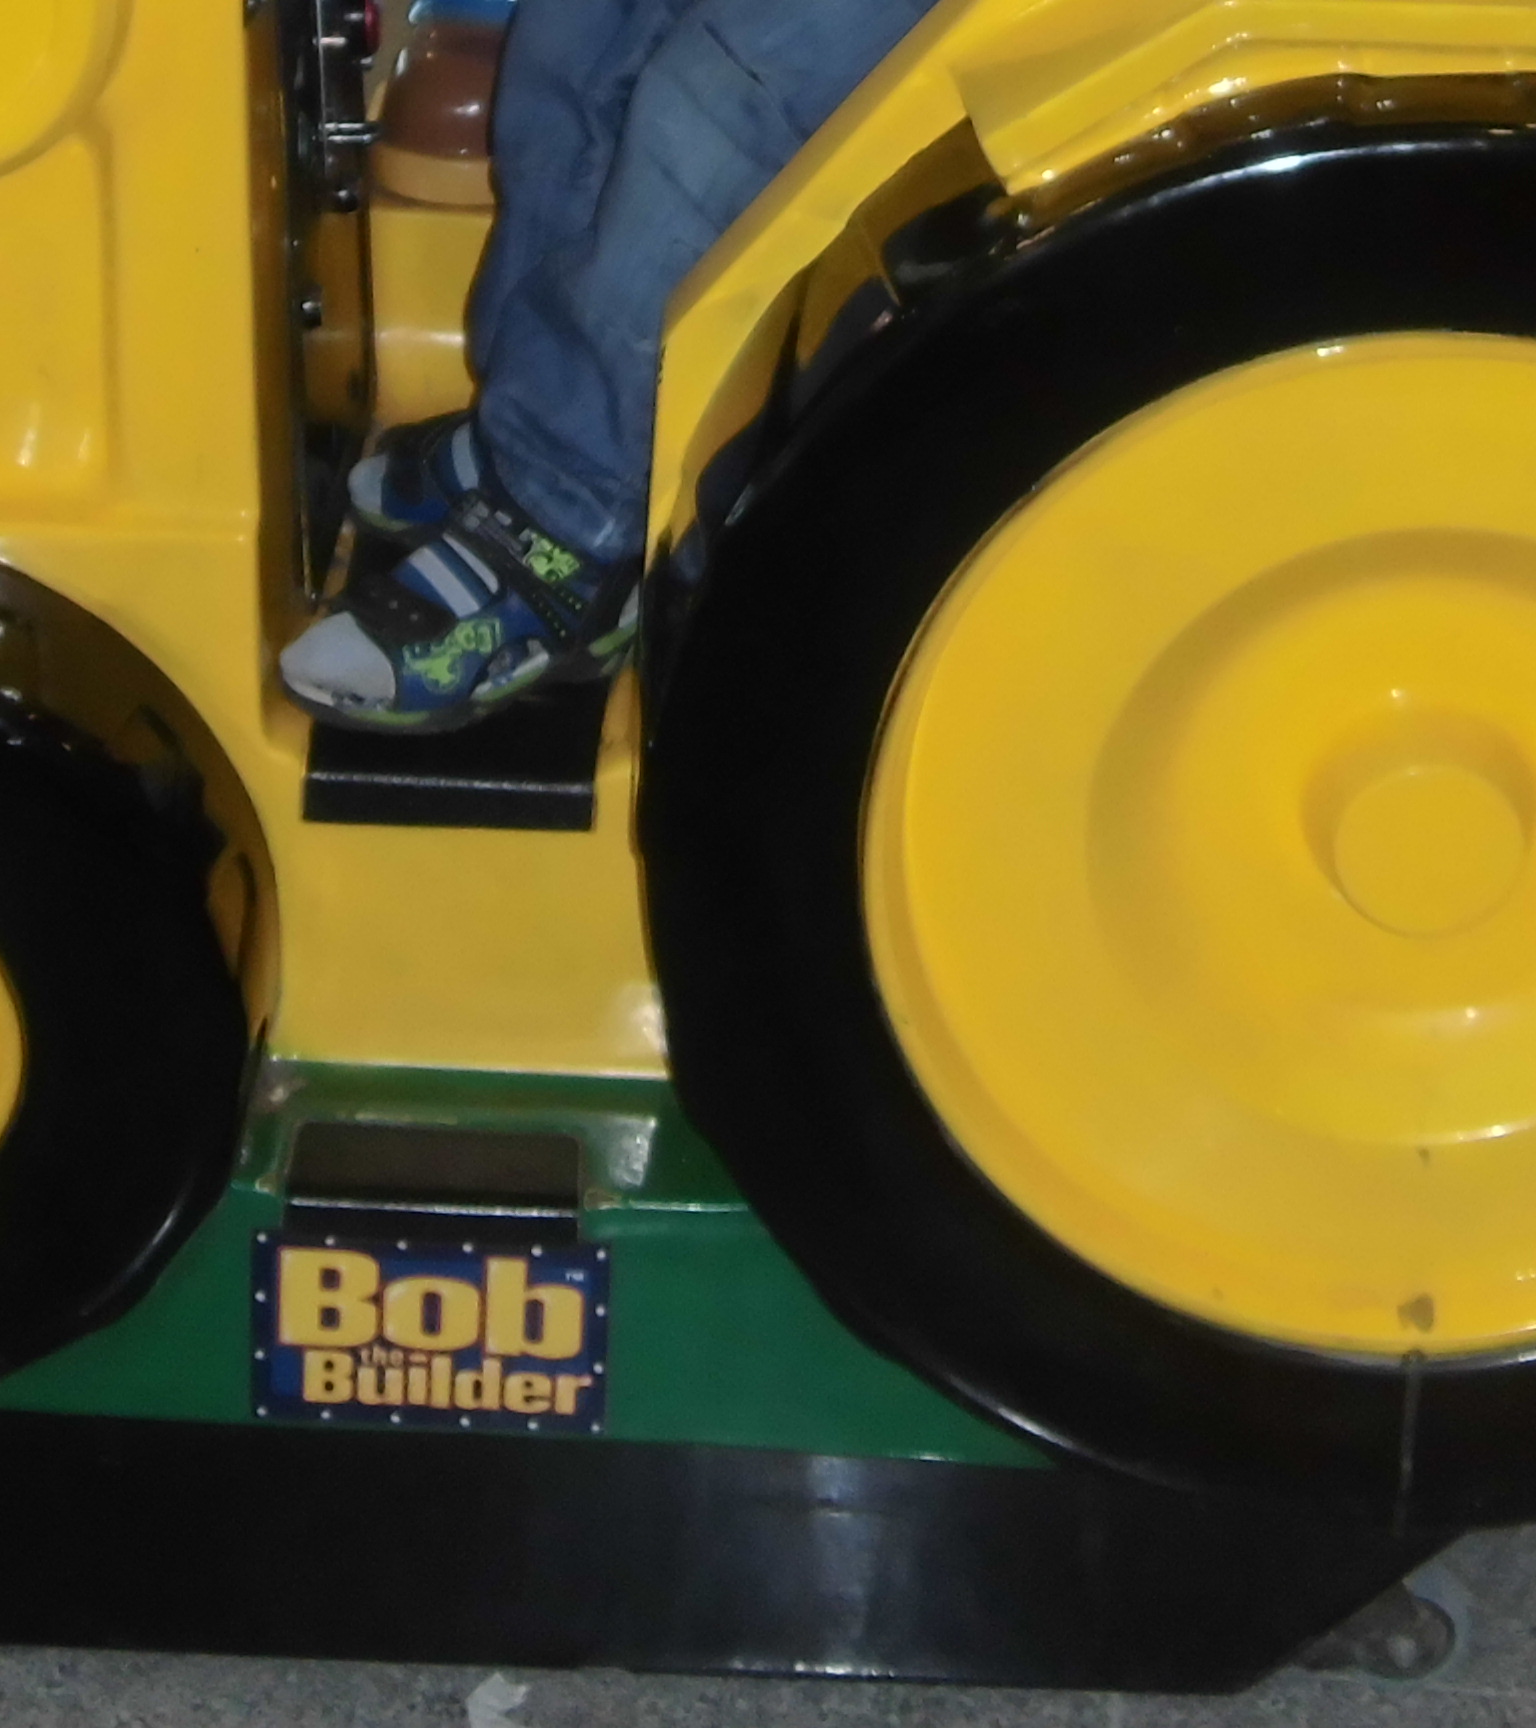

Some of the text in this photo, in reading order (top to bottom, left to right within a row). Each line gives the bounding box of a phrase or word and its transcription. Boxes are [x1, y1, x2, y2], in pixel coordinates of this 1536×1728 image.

[278, 1248, 584, 1360] Bob
[302, 1349, 593, 1415] Builder
[360, 1344, 405, 1367] the
